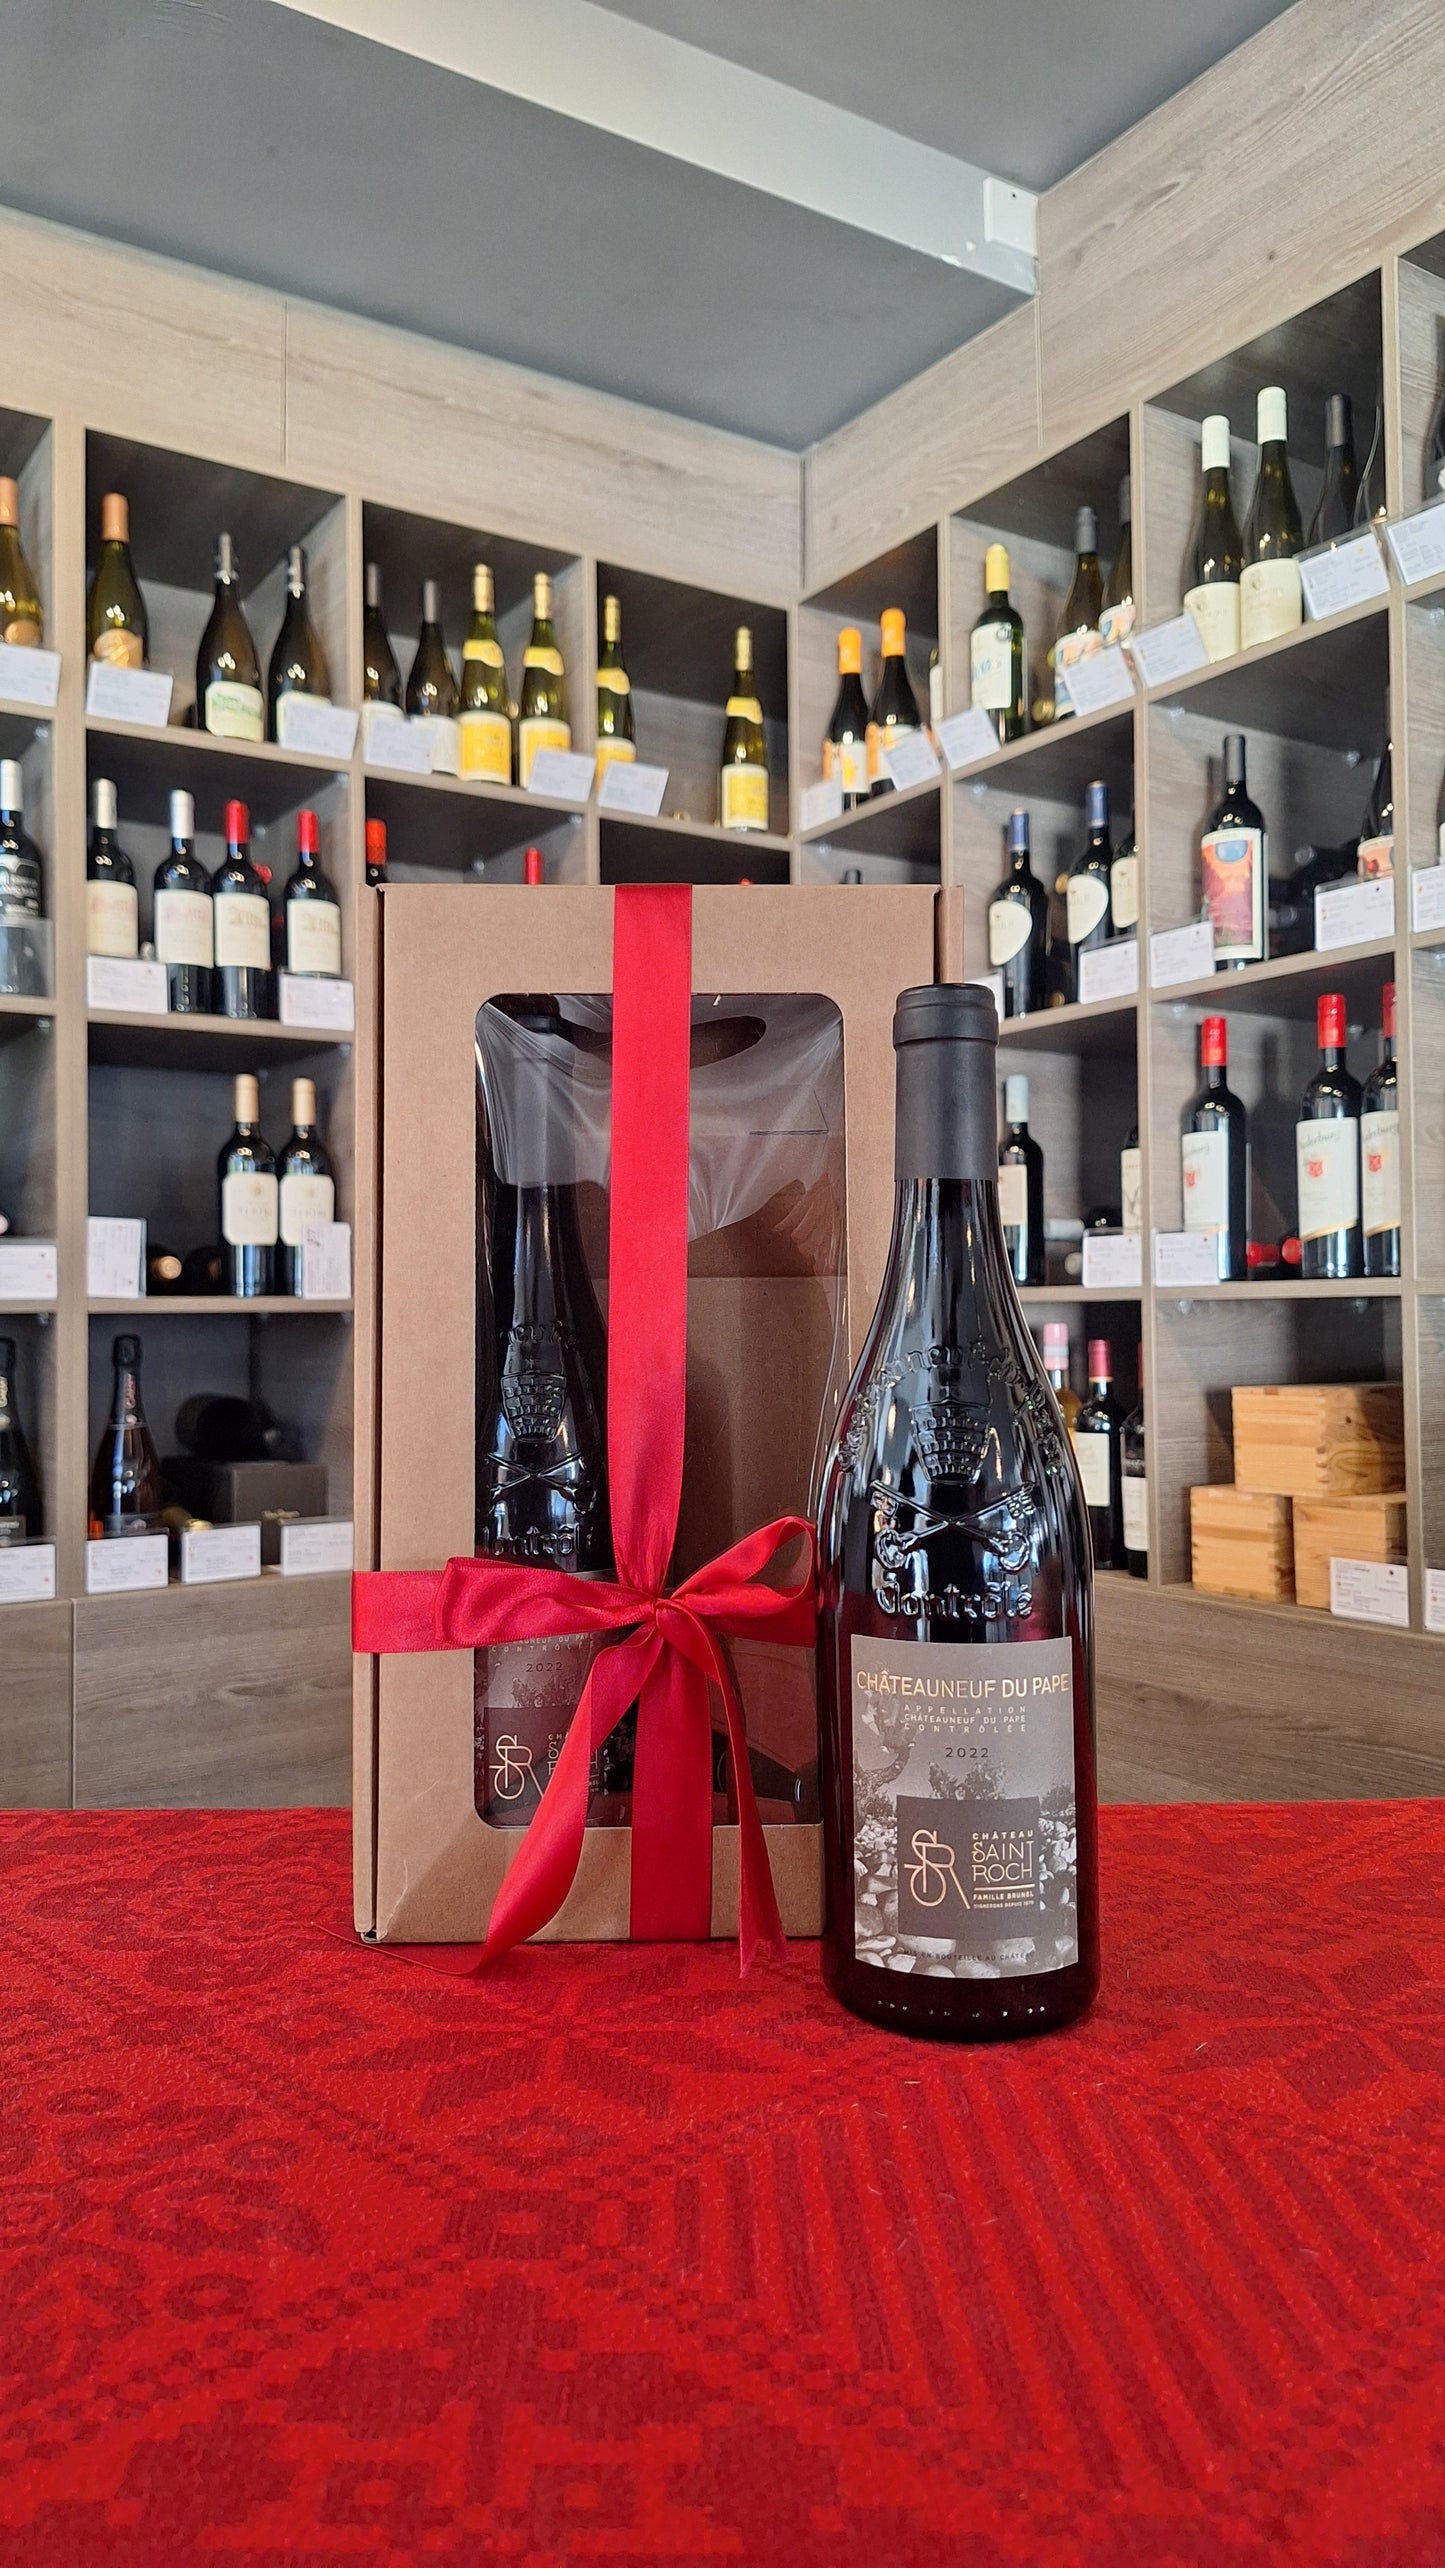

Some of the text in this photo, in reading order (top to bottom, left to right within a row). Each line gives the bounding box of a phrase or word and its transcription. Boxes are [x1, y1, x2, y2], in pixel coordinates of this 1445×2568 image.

[525, 1662, 563, 1673] 2022
[856, 1669, 1070, 1698] CHÂTEAUNEUF DU PAPE
[904, 1704, 1026, 1715] APPELLATION
[904, 1713, 1026, 1724] CHÂTEAUNEUF DU PAPE
[904, 1722, 1026, 1734] CONTRÔLÉE
[945, 1747, 989, 1759] 2022
[972, 1829, 1034, 1840] CHÂTEAU
[971, 1840, 1035, 1863] SAINT
[971, 1862, 1033, 1884] ROCH
[973, 1890, 1035, 1901] FAMILLE BRUNEL
[935, 1953, 984, 1962] BOUTEILLE
